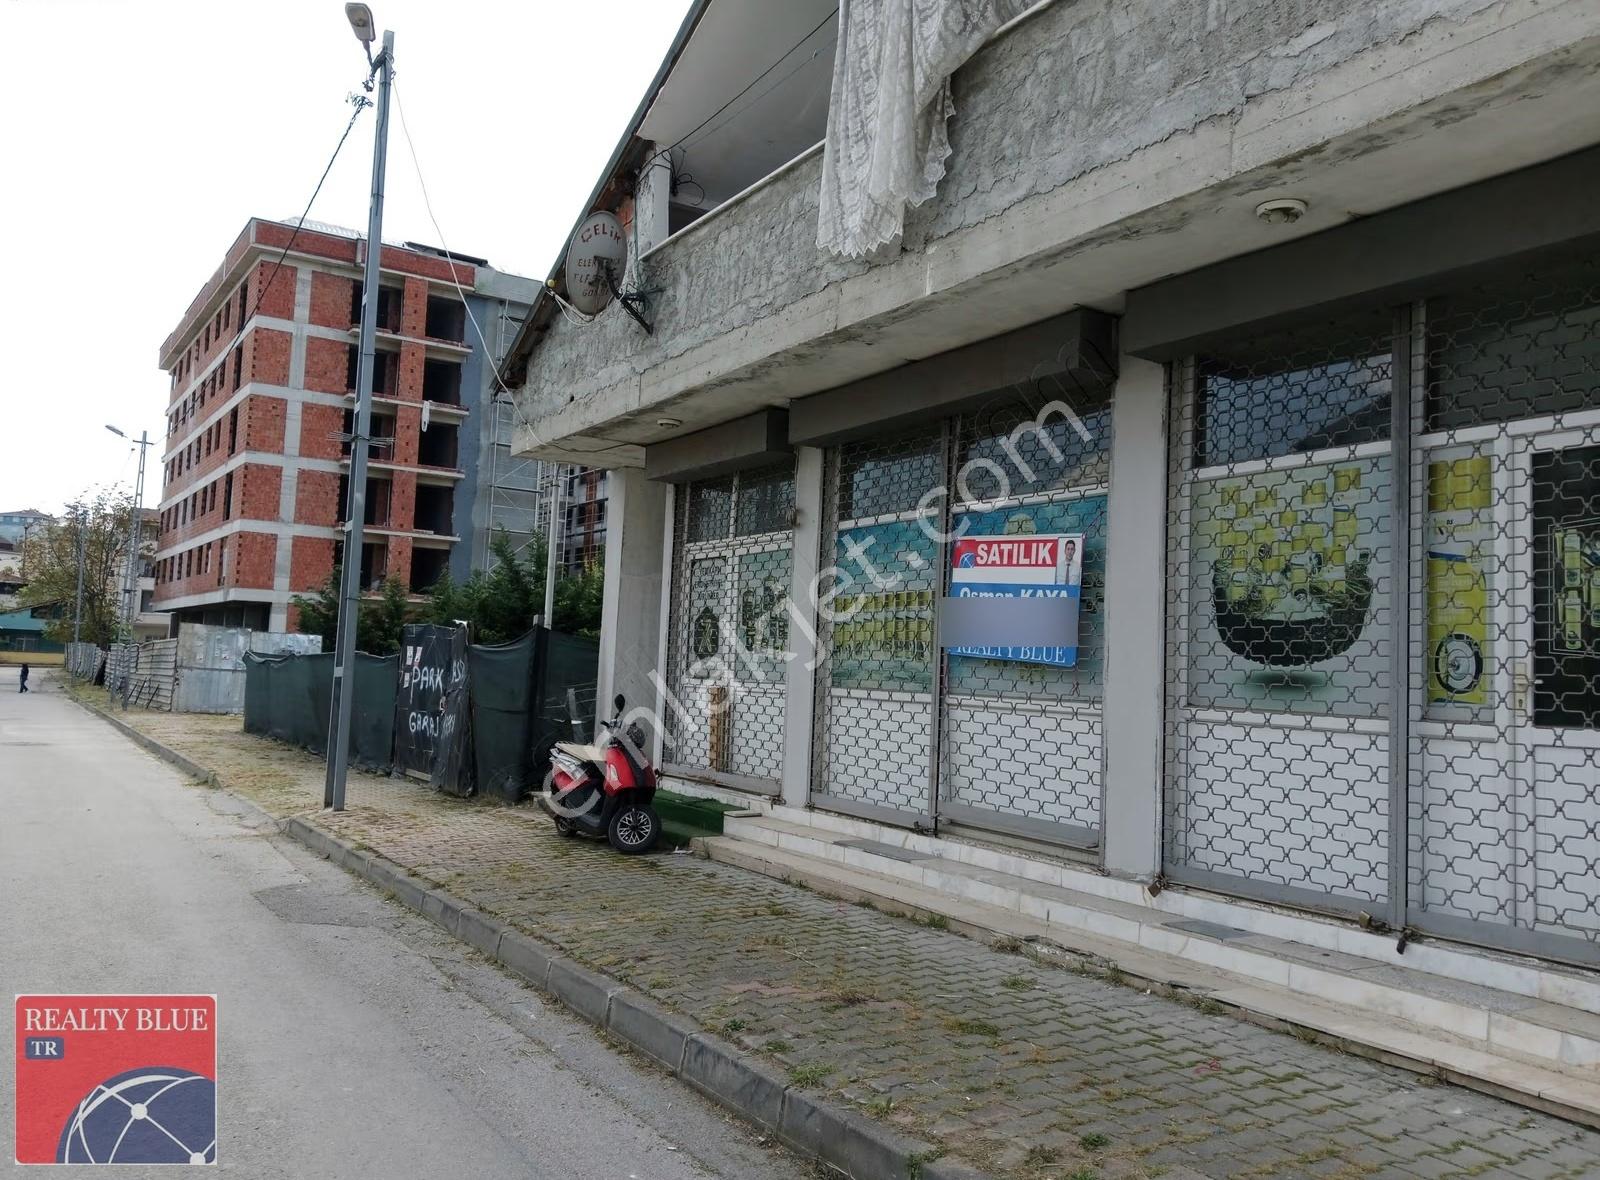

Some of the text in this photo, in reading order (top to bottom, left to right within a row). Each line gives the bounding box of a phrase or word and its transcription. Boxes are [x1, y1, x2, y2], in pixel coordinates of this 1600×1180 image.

[976, 542, 1054, 566] SATILIK
[1020, 646, 1066, 664] BLUE
[410, 666, 444, 704] PARK
